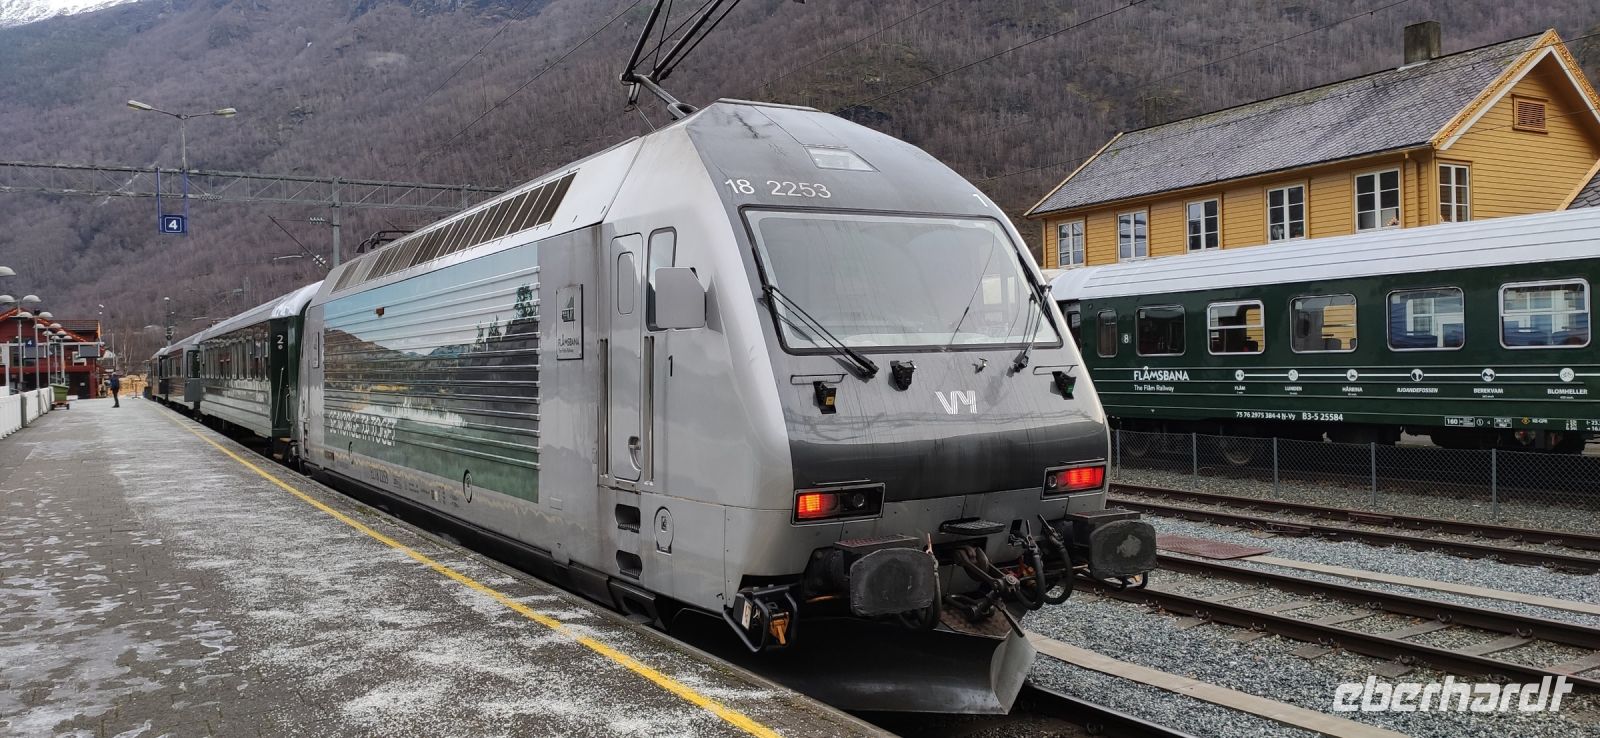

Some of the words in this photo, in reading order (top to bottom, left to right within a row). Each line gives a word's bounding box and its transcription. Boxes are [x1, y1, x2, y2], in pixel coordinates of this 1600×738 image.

[725, 178, 755, 195] 18
[766, 179, 832, 199] 2253
[168, 218, 179, 231] 4
[276, 334, 285, 345] 2
[668, 354, 674, 378] 1
[1133, 366, 1190, 381] FLÅMSBANA
[1155, 384, 1175, 393] Railway
[1473, 387, 1504, 395] BEREKVAM
[1302, 412, 1319, 421] B3-5
[1319, 413, 1344, 421] 25584
